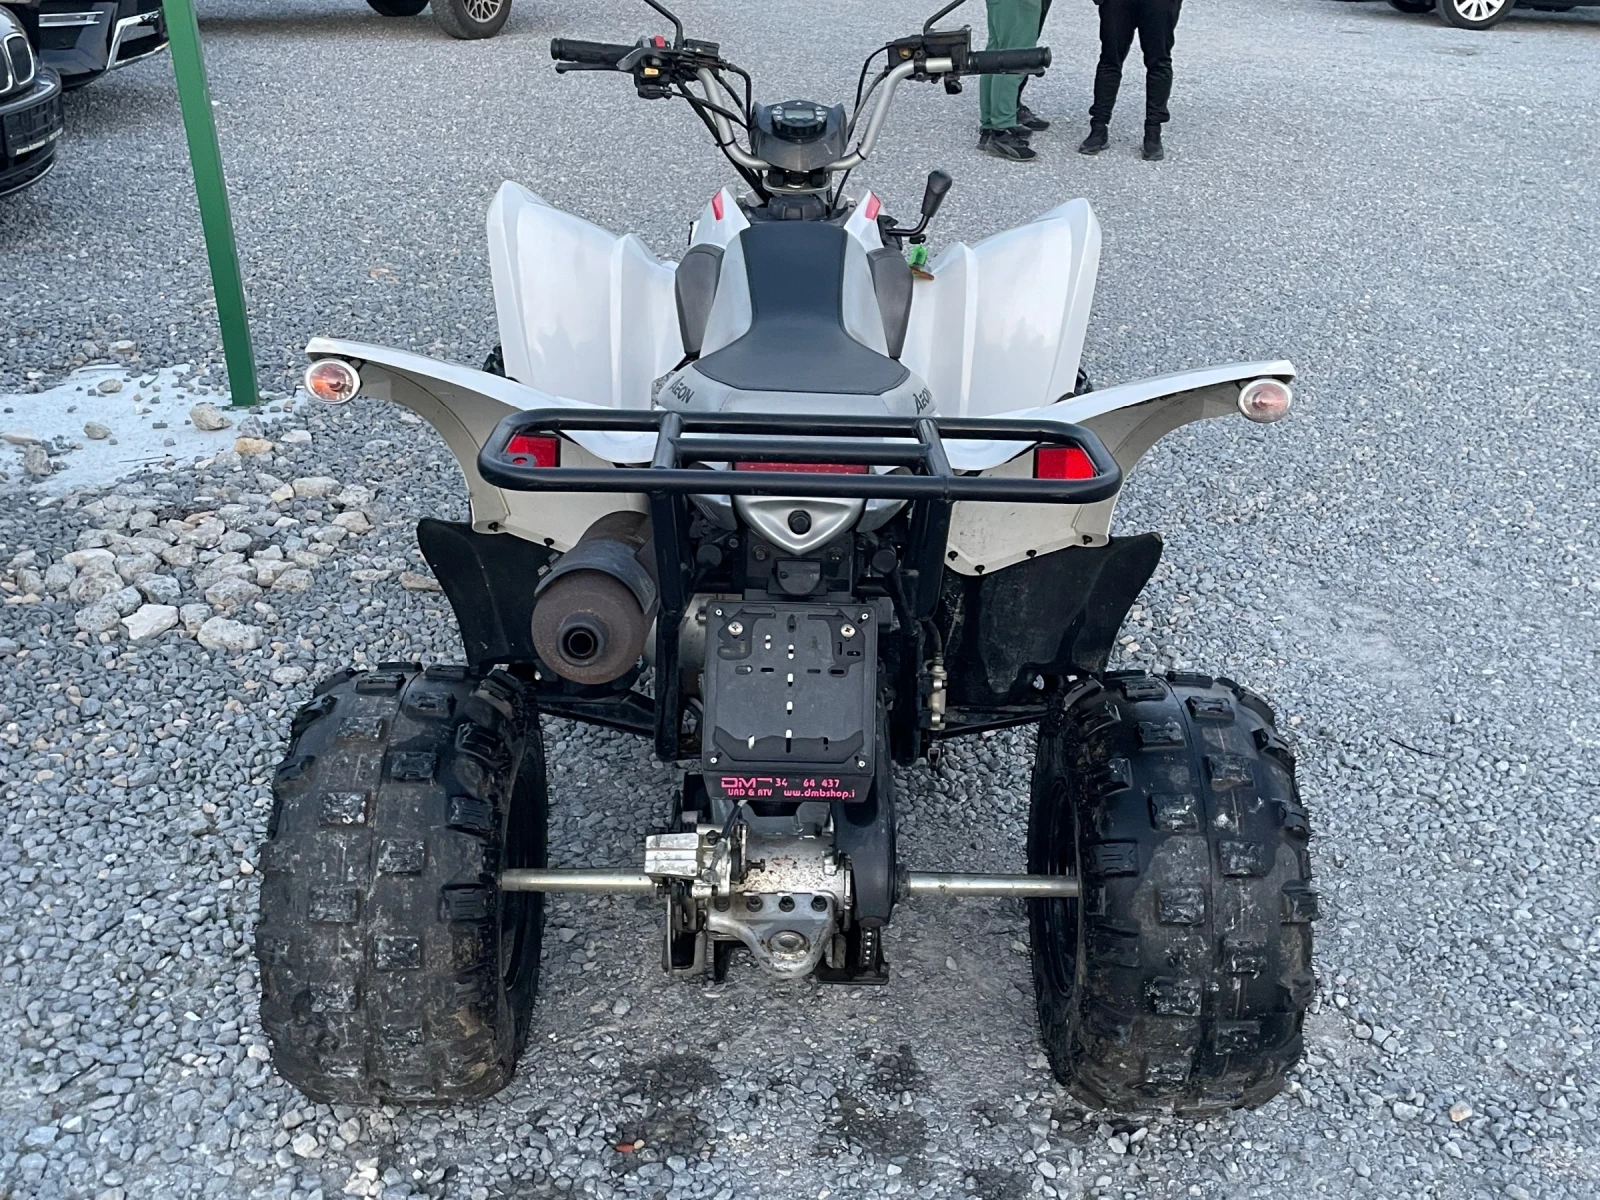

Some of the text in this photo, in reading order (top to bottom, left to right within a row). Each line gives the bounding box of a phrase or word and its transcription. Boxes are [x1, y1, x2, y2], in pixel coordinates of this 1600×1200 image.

[803, 778, 815, 787] 64
[821, 778, 840, 788] 437
[748, 788, 755, 796] &
[757, 788, 773, 796] ATV
